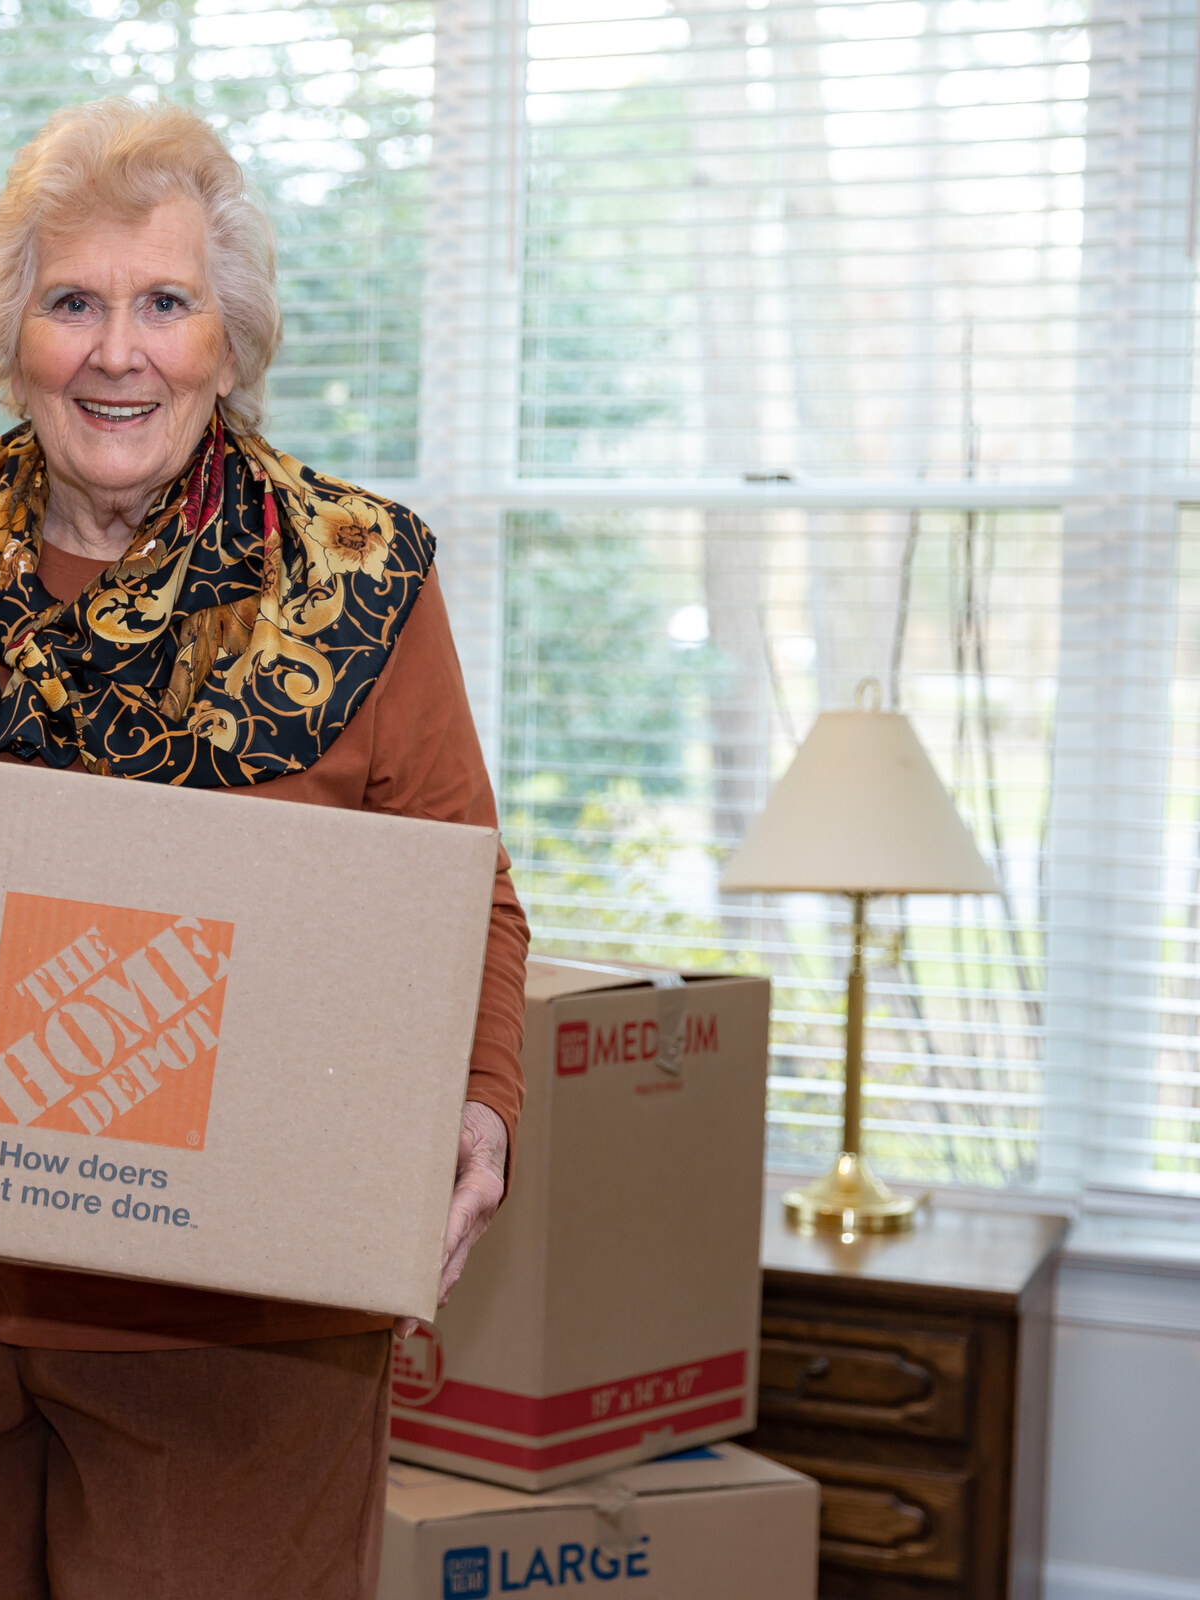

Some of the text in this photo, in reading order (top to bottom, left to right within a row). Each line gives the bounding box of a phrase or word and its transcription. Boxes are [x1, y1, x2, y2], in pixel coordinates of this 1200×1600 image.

[14, 926, 118, 1012] THE
[592, 1014, 719, 1067] MEDUM
[67, 1003, 219, 1136] DEPOT
[20, 1184, 102, 1214] more
[78, 1154, 168, 1189] doers
[499, 1535, 650, 1592] LARGE
